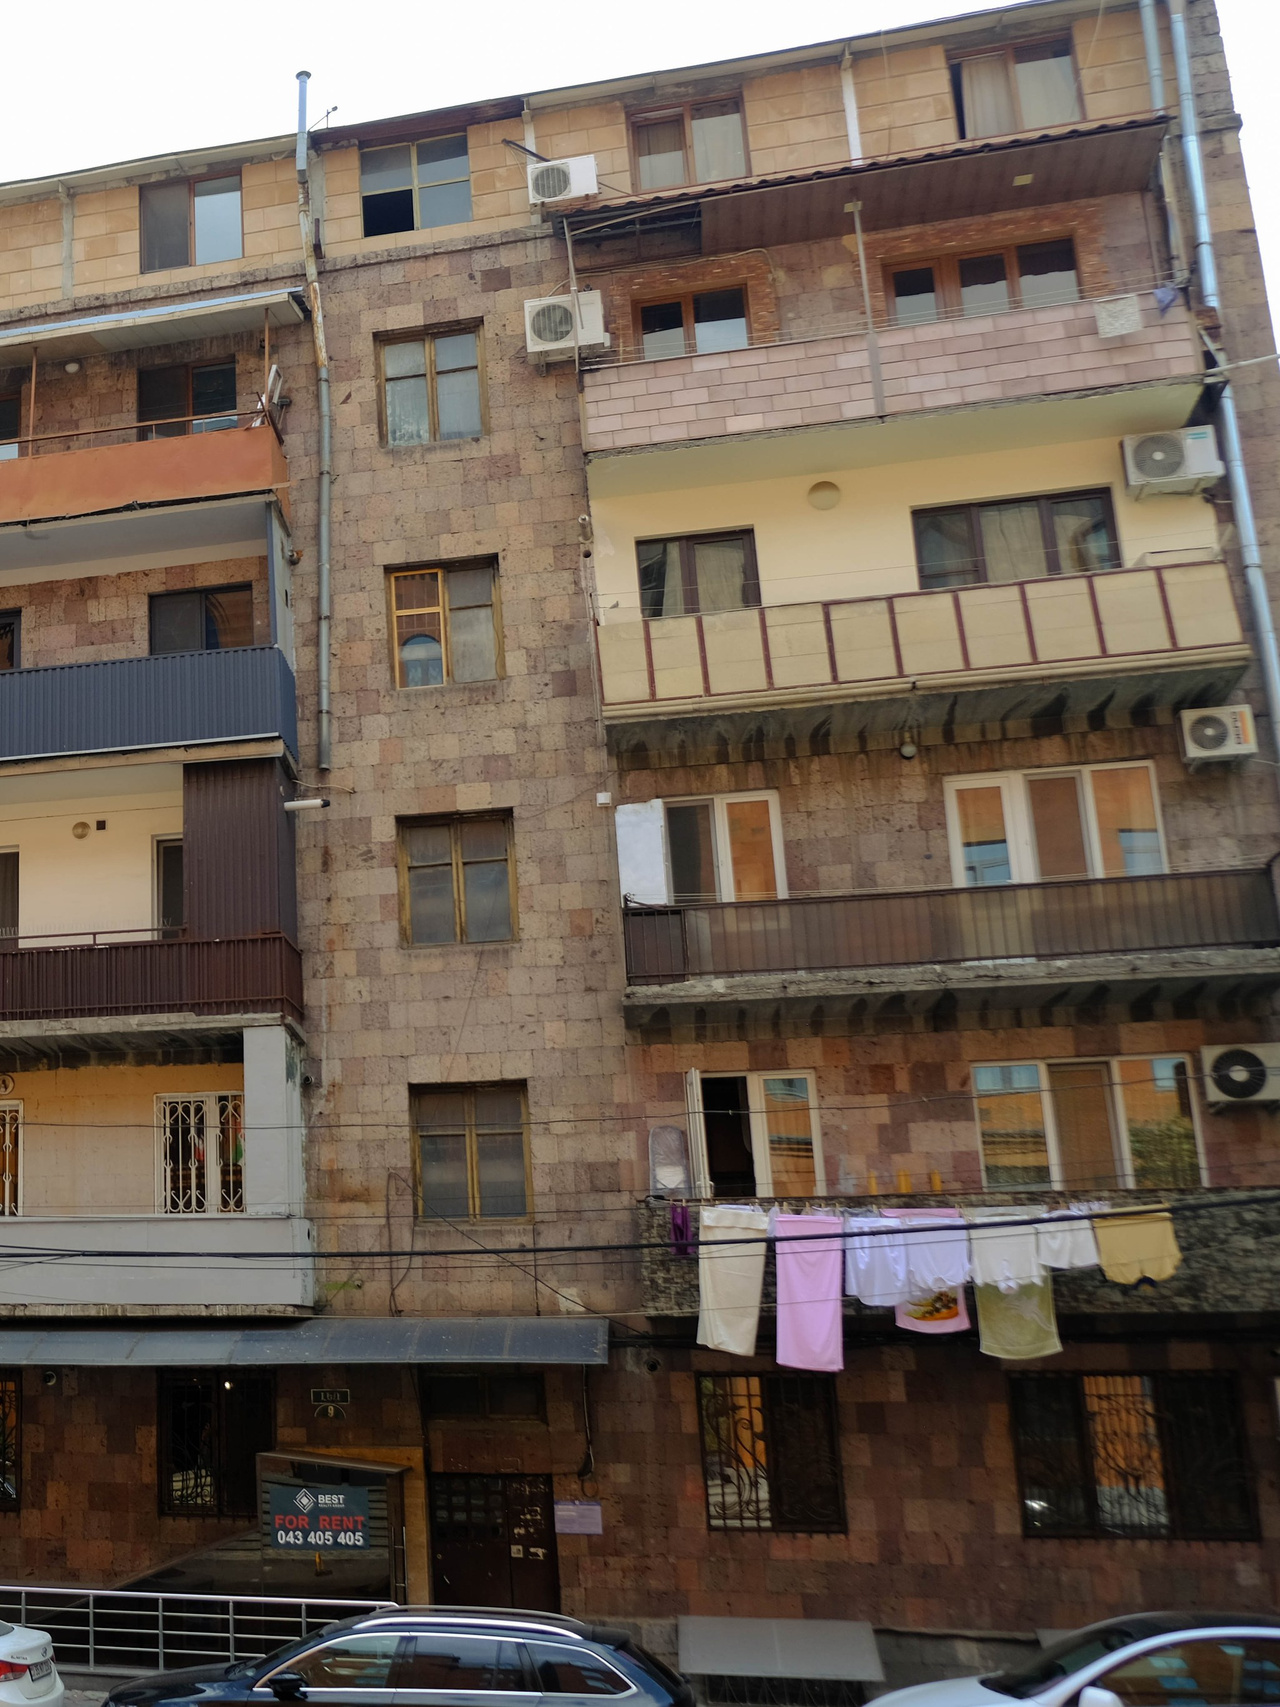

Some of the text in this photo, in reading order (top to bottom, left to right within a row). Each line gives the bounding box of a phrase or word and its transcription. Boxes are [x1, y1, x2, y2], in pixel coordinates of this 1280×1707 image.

[327, 1405, 334, 1418] 9
[317, 1494, 345, 1504] BEST
[274, 1514, 365, 1531] FOR RENT
[277, 1530, 365, 1547] 043 405 405
